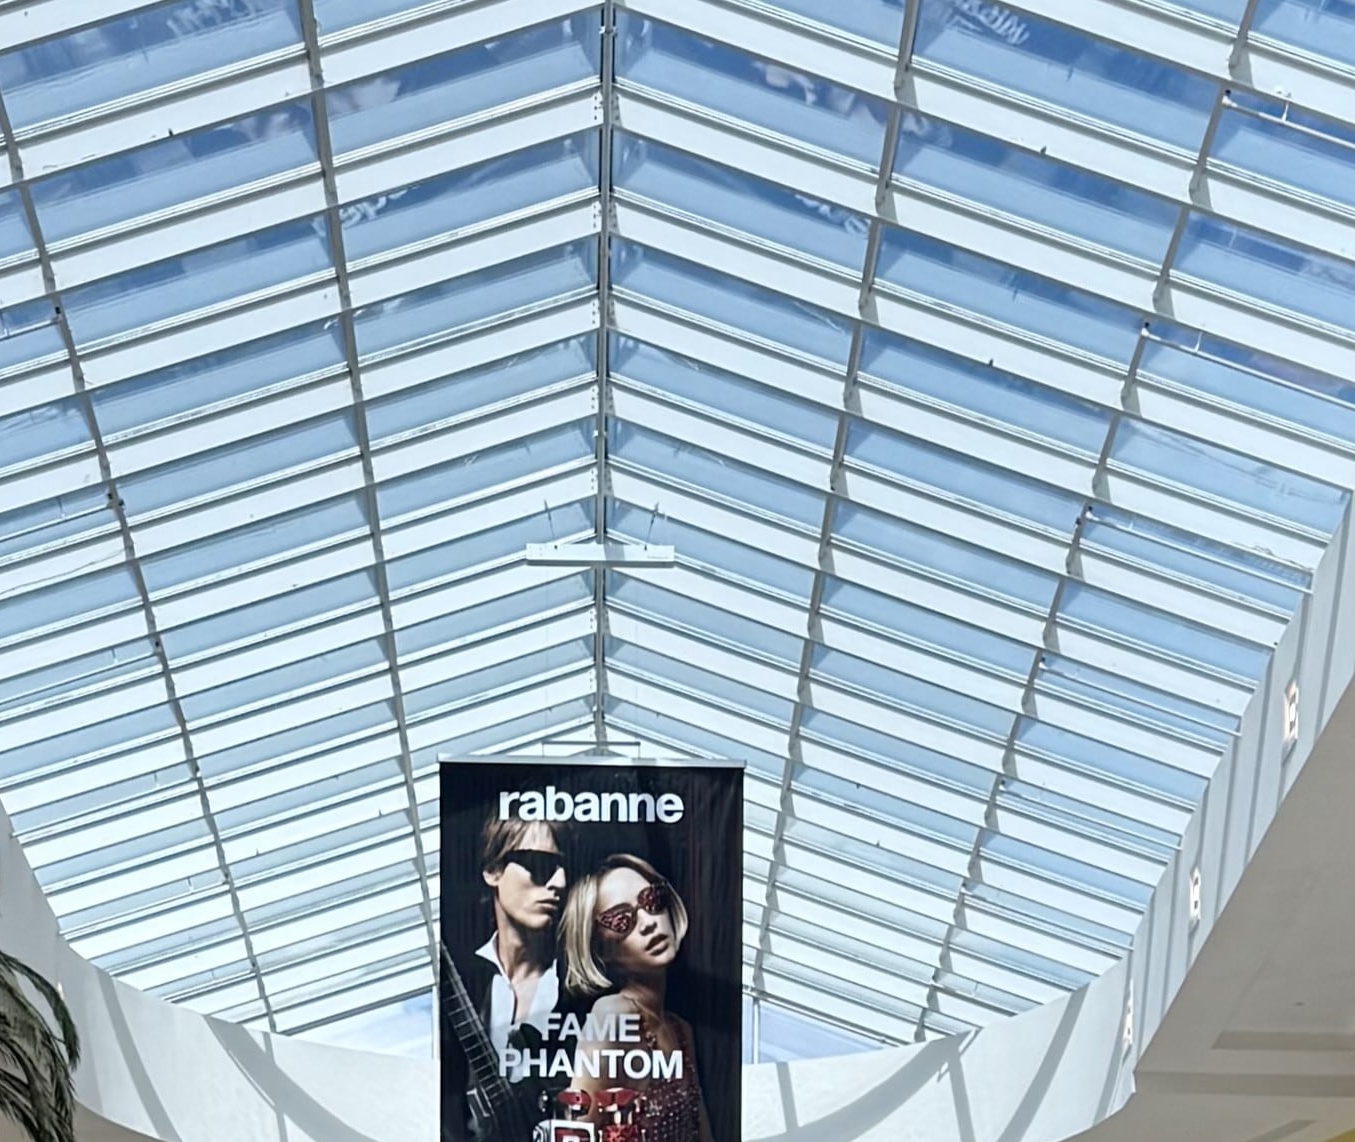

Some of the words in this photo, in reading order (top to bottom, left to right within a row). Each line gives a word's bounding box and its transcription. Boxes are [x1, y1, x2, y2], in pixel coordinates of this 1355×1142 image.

[499, 787, 684, 823] rabanne
[541, 1013, 640, 1043] FAME
[499, 1049, 683, 1079] PHANTOM
